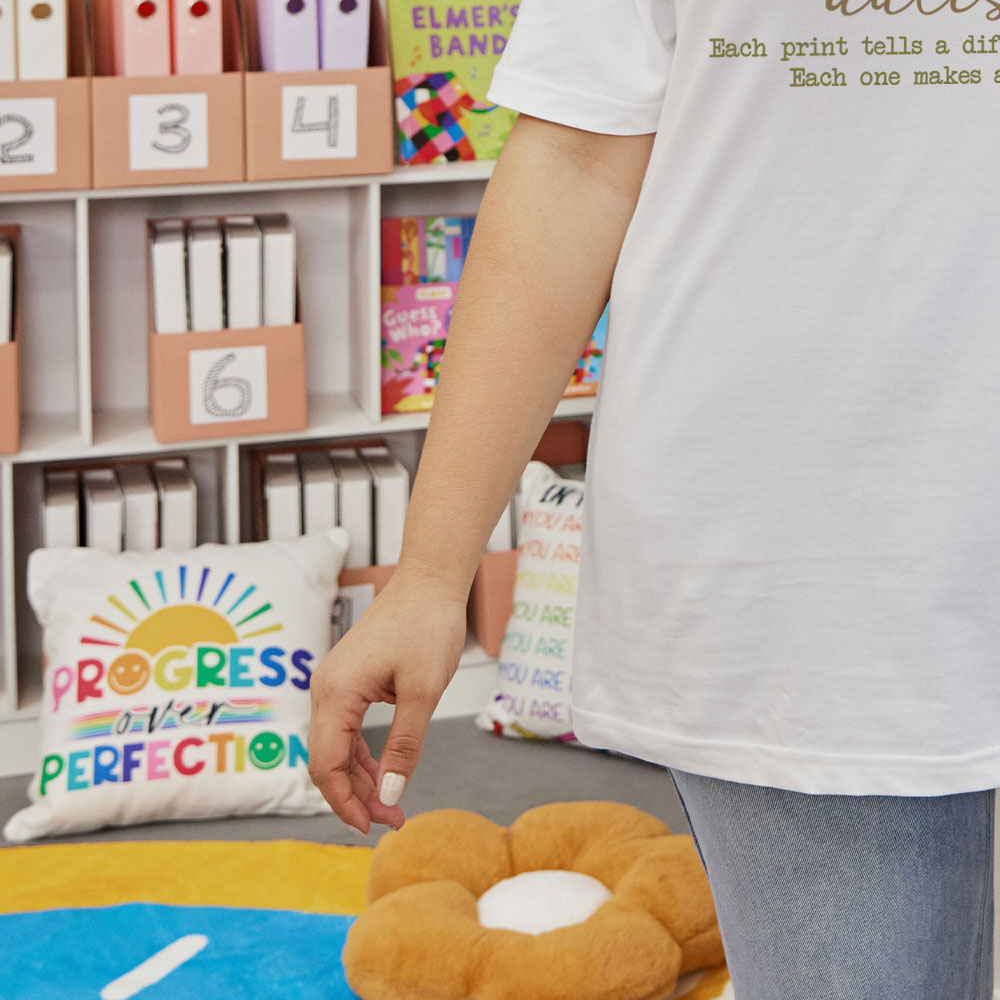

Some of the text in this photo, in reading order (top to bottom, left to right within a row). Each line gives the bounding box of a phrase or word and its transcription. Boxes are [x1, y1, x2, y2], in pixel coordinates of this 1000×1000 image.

[709, 38, 767, 59] Each
[780, 36, 849, 61] print
[861, 36, 923, 57] tells
[935, 41, 950, 55] a
[789, 67, 847, 87] Each
[859, 71, 901, 86] one
[913, 66, 981, 86] makes
[0, 114, 34, 163] 2
[152, 103, 192, 154] 3
[292, 96, 338, 148] 4
[203, 353, 252, 417] 6
[116, 699, 240, 734] over
